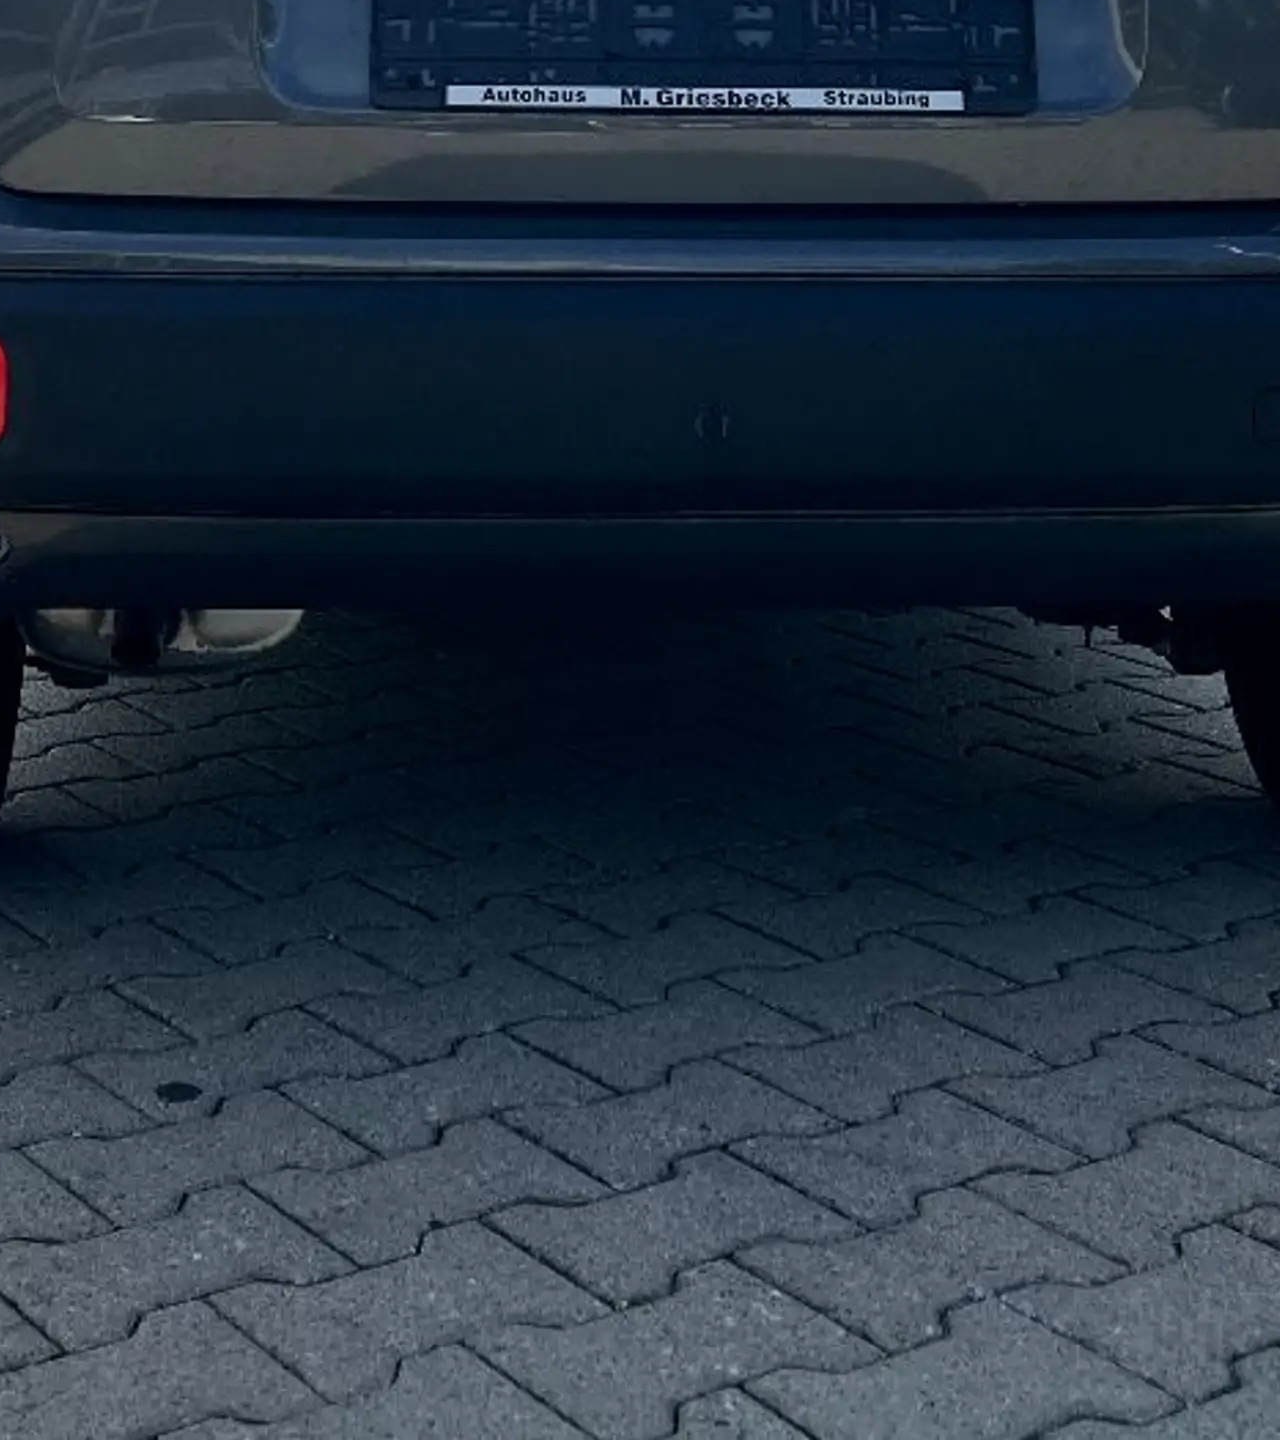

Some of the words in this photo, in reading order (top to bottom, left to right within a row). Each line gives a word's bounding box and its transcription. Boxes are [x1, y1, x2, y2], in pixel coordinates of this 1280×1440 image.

[482, 87, 587, 104] Autohaus
[621, 88, 650, 107] M.
[656, 90, 792, 108] Griesbeck
[823, 90, 931, 109] Straubing
